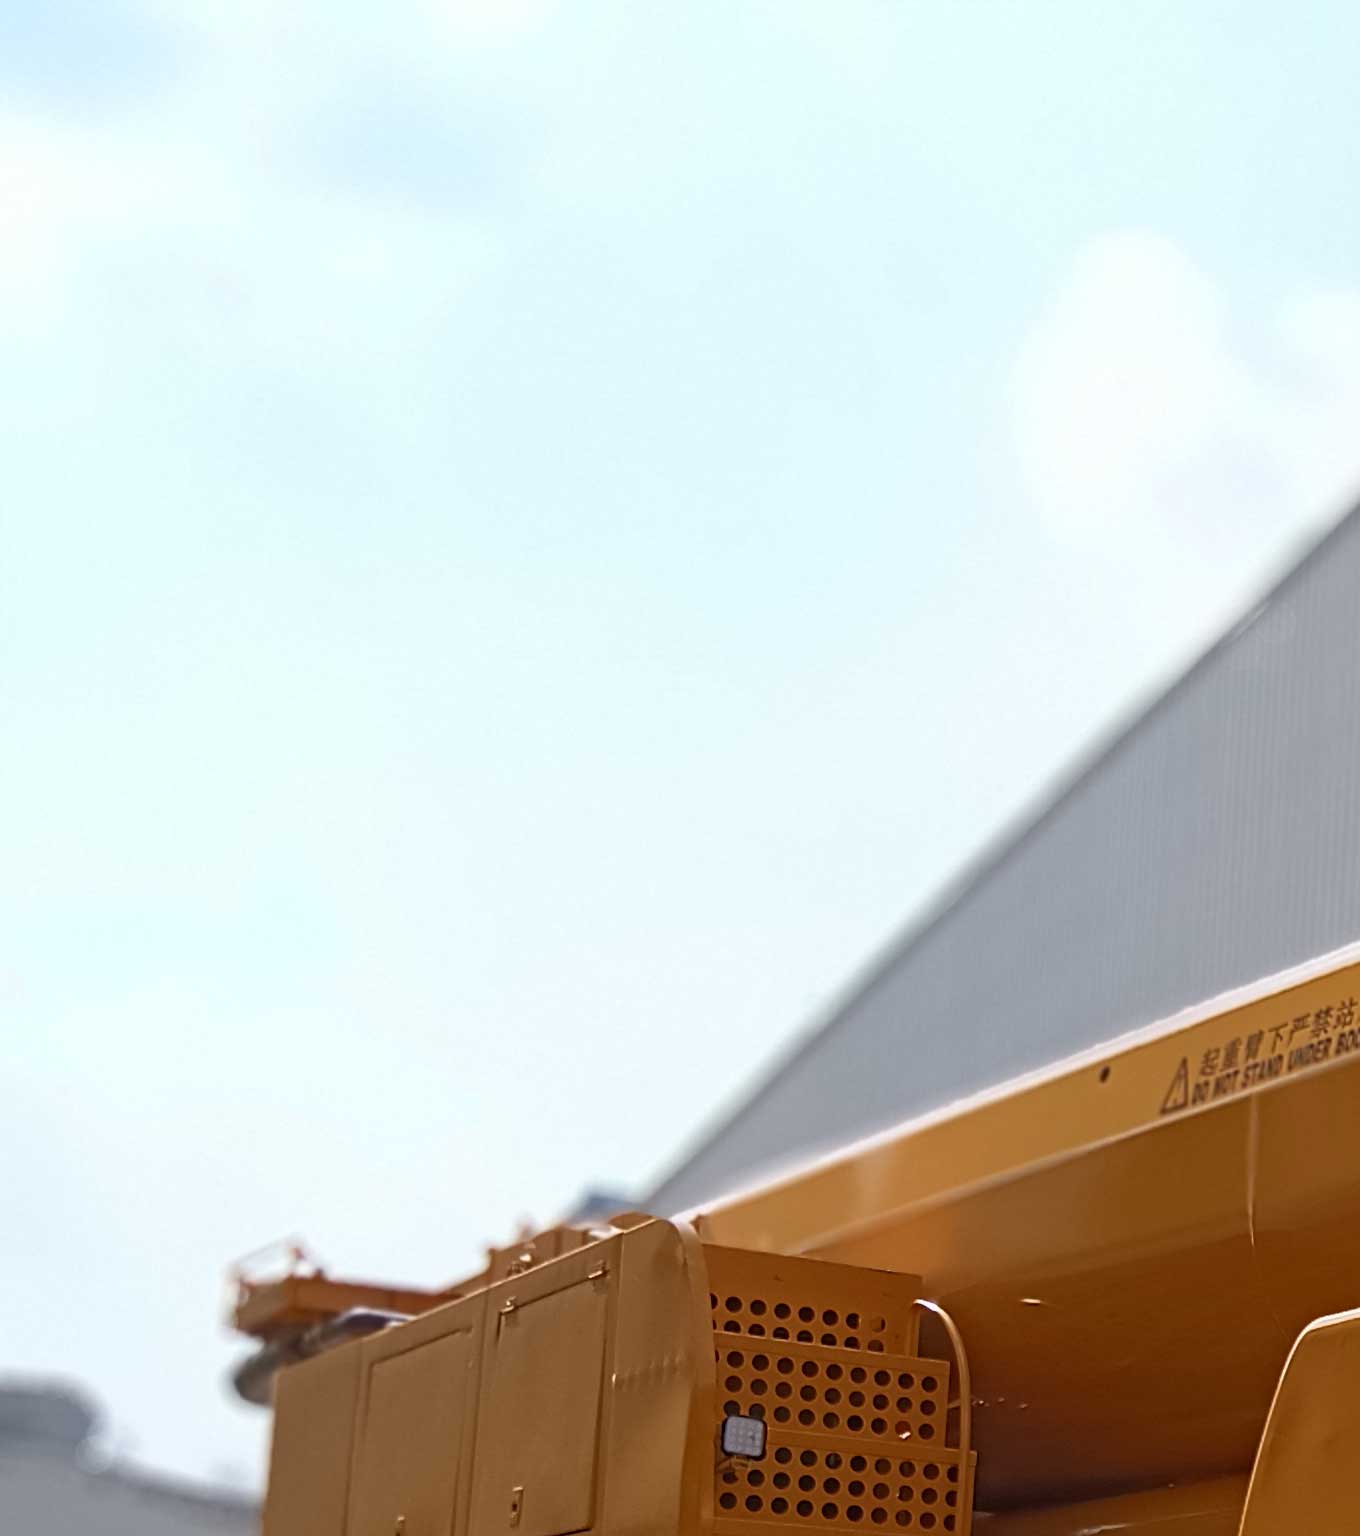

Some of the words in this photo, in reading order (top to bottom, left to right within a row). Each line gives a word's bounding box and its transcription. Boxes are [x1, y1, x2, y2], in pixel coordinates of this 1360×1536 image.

[1191, 1078, 1211, 1106] DO
[1211, 1067, 1240, 1102] NOT
[1241, 1053, 1284, 1090] STAND
[1286, 1037, 1331, 1074] UNDER
